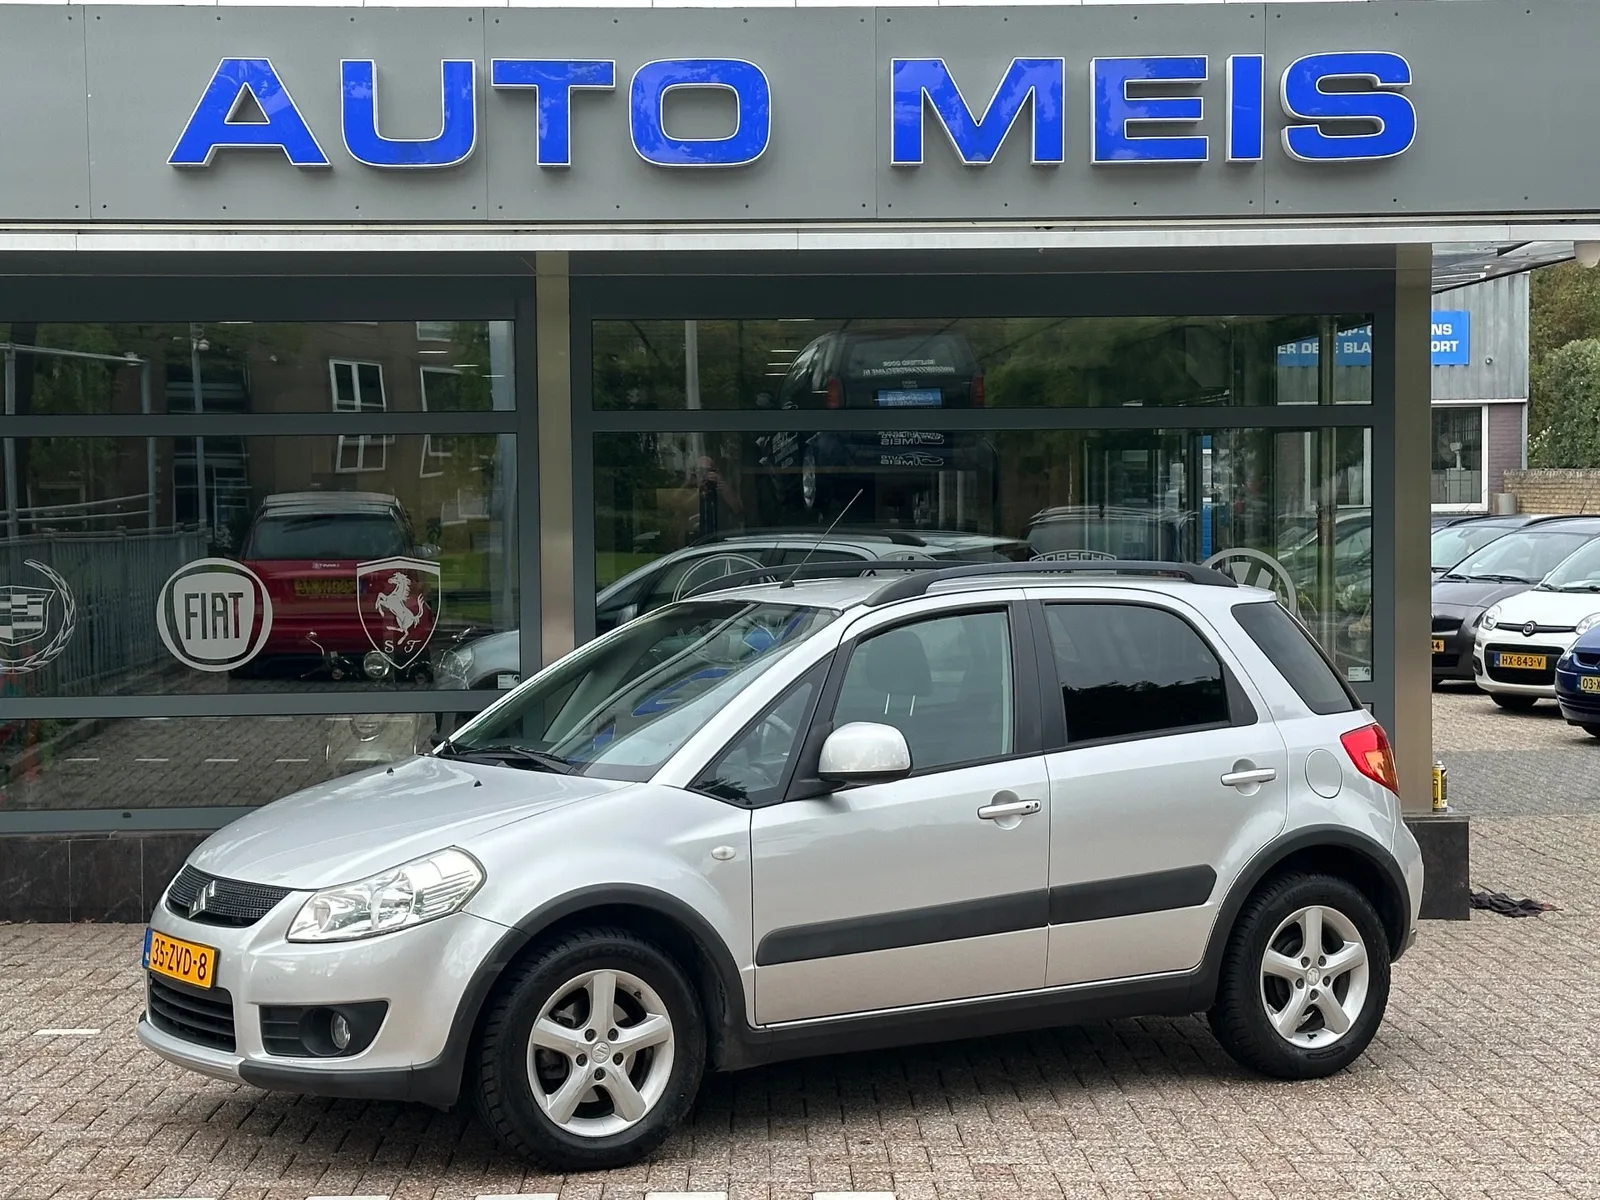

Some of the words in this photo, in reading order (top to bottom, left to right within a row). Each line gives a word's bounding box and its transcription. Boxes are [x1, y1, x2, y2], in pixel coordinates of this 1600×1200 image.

[166, 57, 772, 168] AUTO
[890, 51, 1417, 166] MEIS
[184, 592, 244, 640] FIAT
[152, 938, 208, 981] 35-ZVD-8
